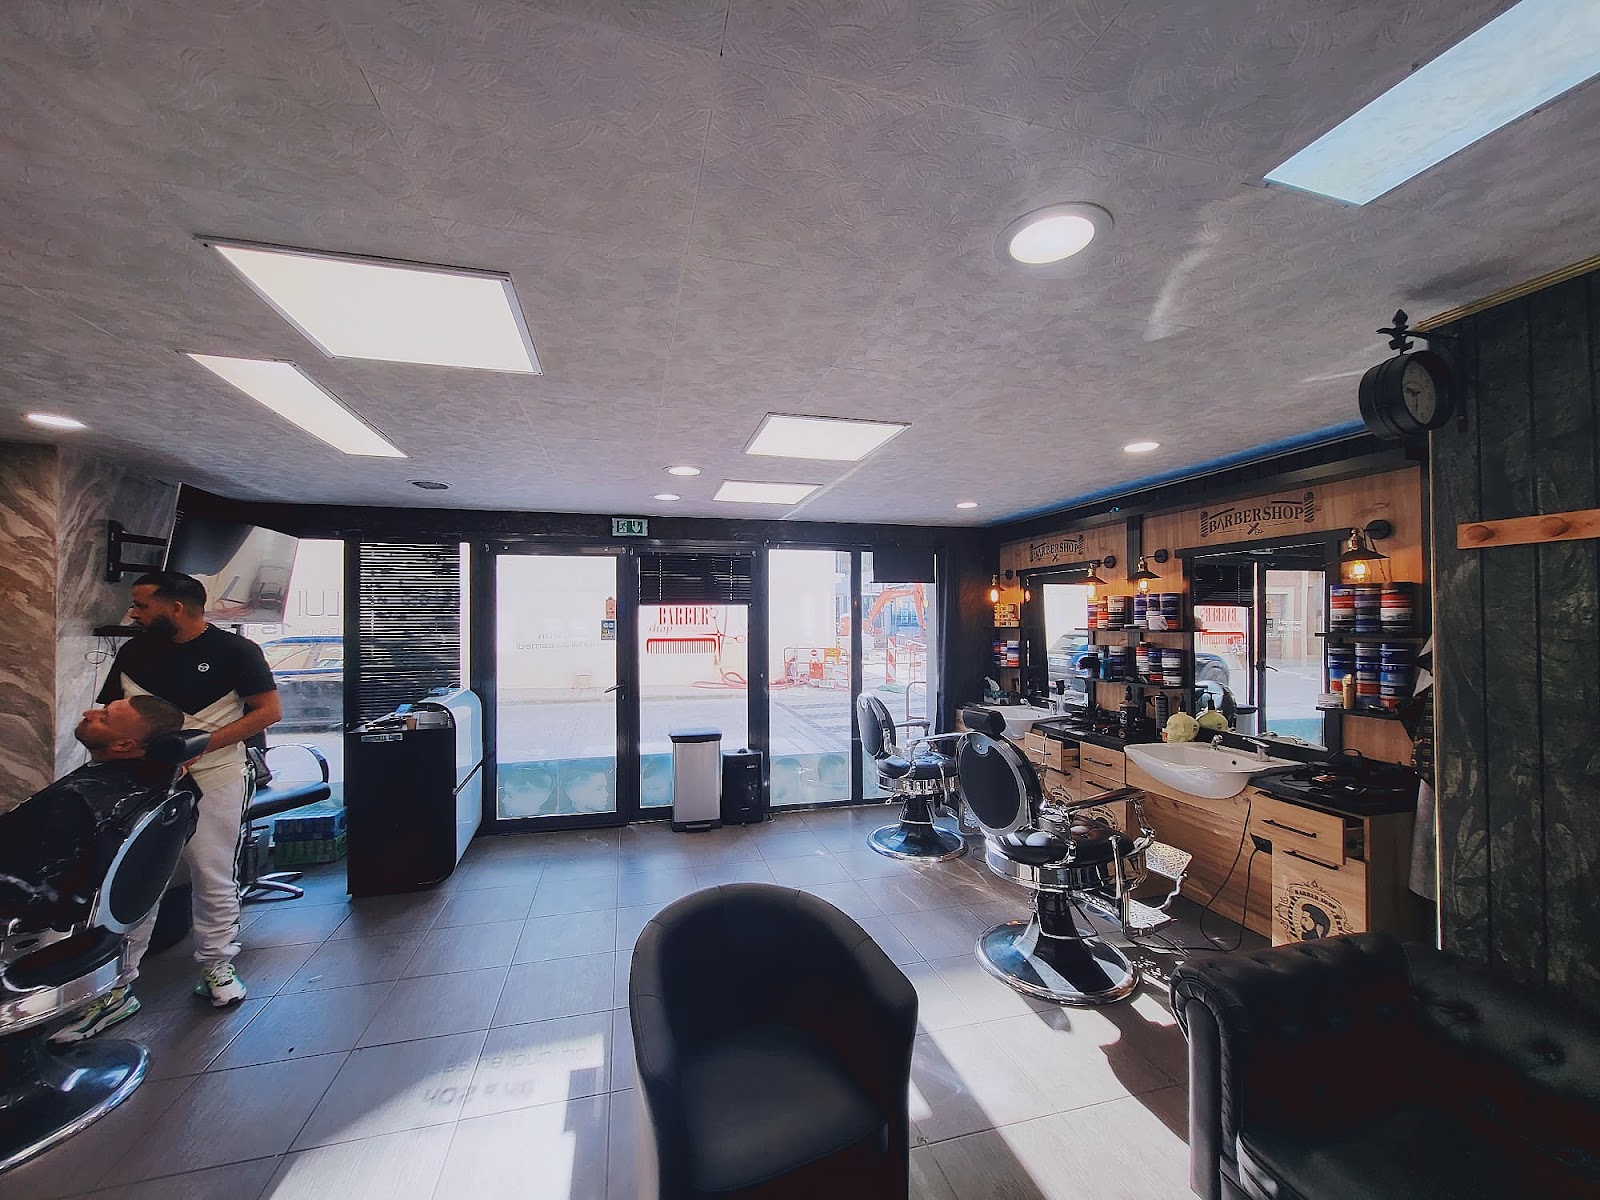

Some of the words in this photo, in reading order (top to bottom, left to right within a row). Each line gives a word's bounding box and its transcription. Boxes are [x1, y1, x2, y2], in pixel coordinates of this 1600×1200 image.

[1208, 505, 1305, 533] BARBERSHOP
[1033, 542, 1079, 559] BARBERSHOP
[659, 607, 710, 625] BARBER
[648, 623, 673, 635] shop
